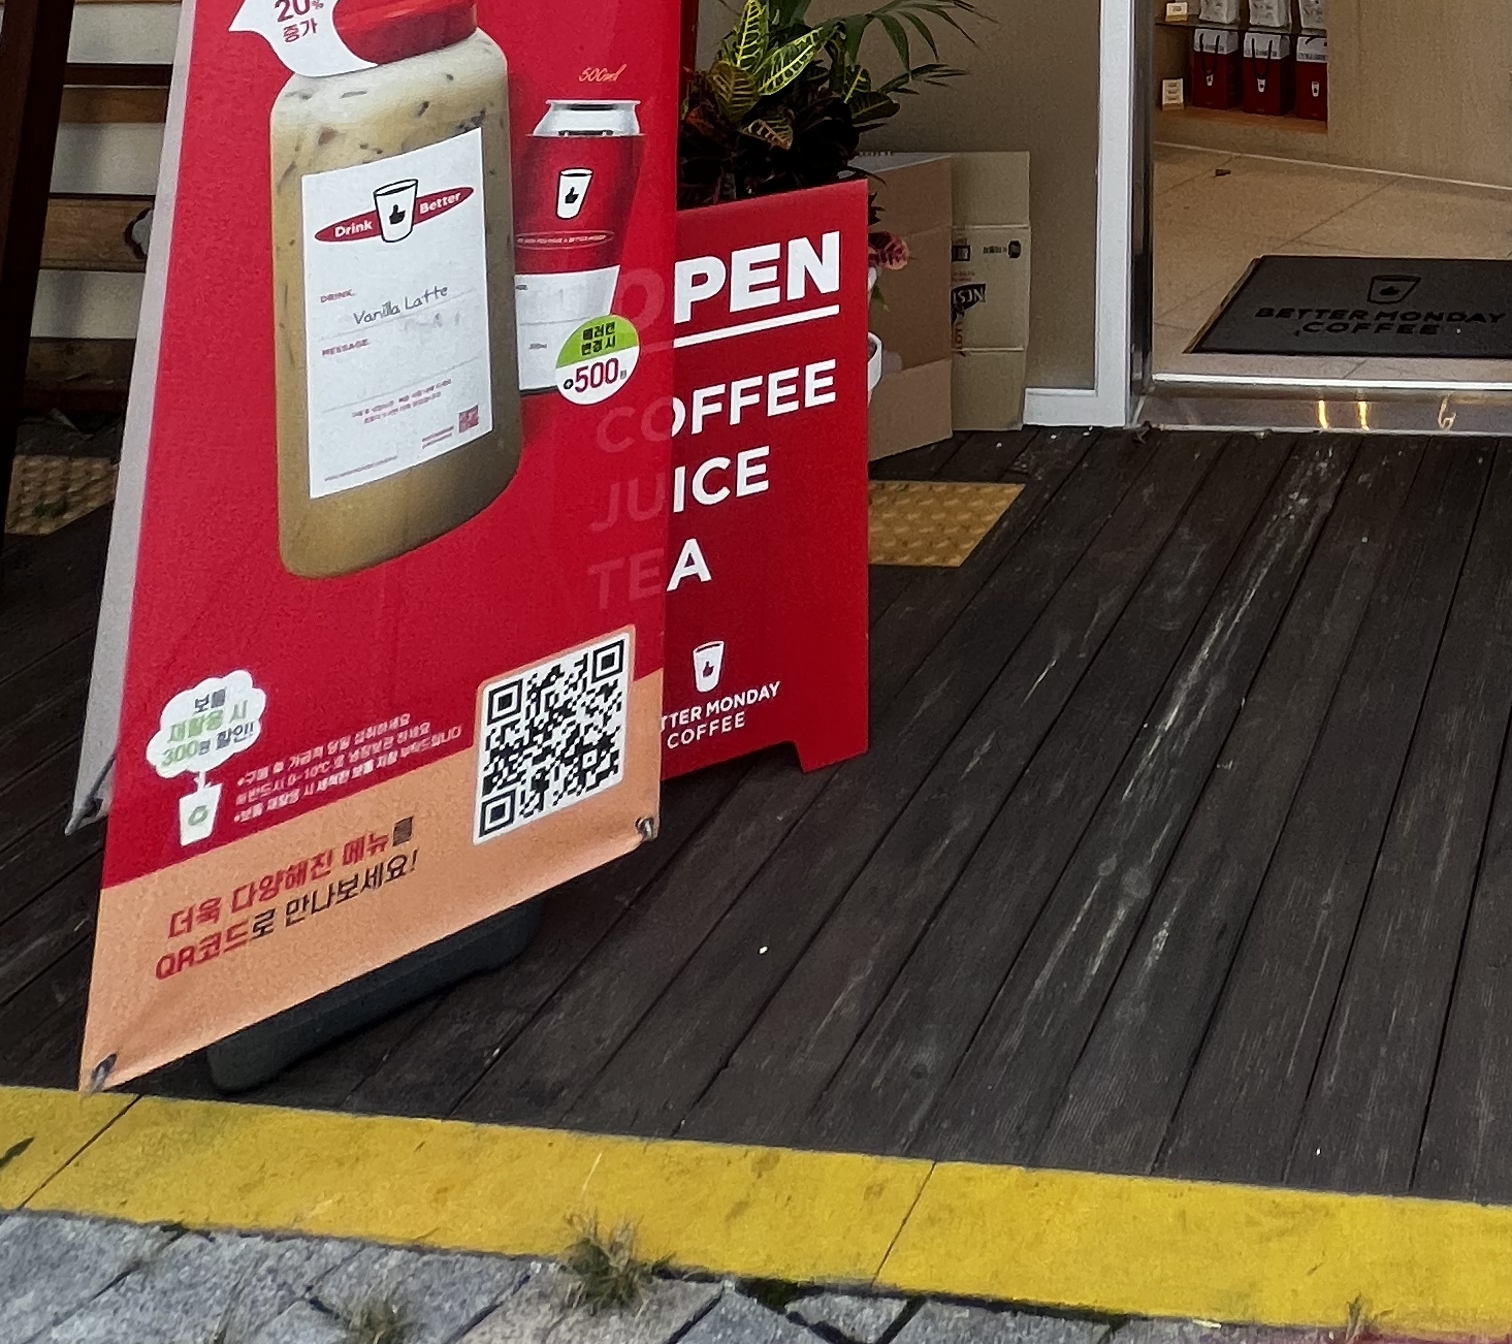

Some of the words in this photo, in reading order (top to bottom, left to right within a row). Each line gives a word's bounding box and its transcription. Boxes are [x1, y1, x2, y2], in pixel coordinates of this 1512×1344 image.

[282, 17, 319, 44] 증가
[334, 218, 374, 239] Drink
[419, 190, 462, 215] Better
[352, 300, 401, 326] Vanilla
[404, 284, 449, 311] Latte
[1254, 306, 1369, 321] BETTER
[1374, 308, 1506, 324] MONDAY
[1301, 321, 1442, 336] COFFEE
[661, 698, 703, 734] TTER
[705, 680, 781, 719] MONDAY
[666, 709, 746, 750] COFFEE
[154, 907, 277, 981] QR코드로
[285, 848, 419, 929] 만나보세요!
[167, 895, 223, 940] 더욱
[230, 848, 335, 915] 다양해진
